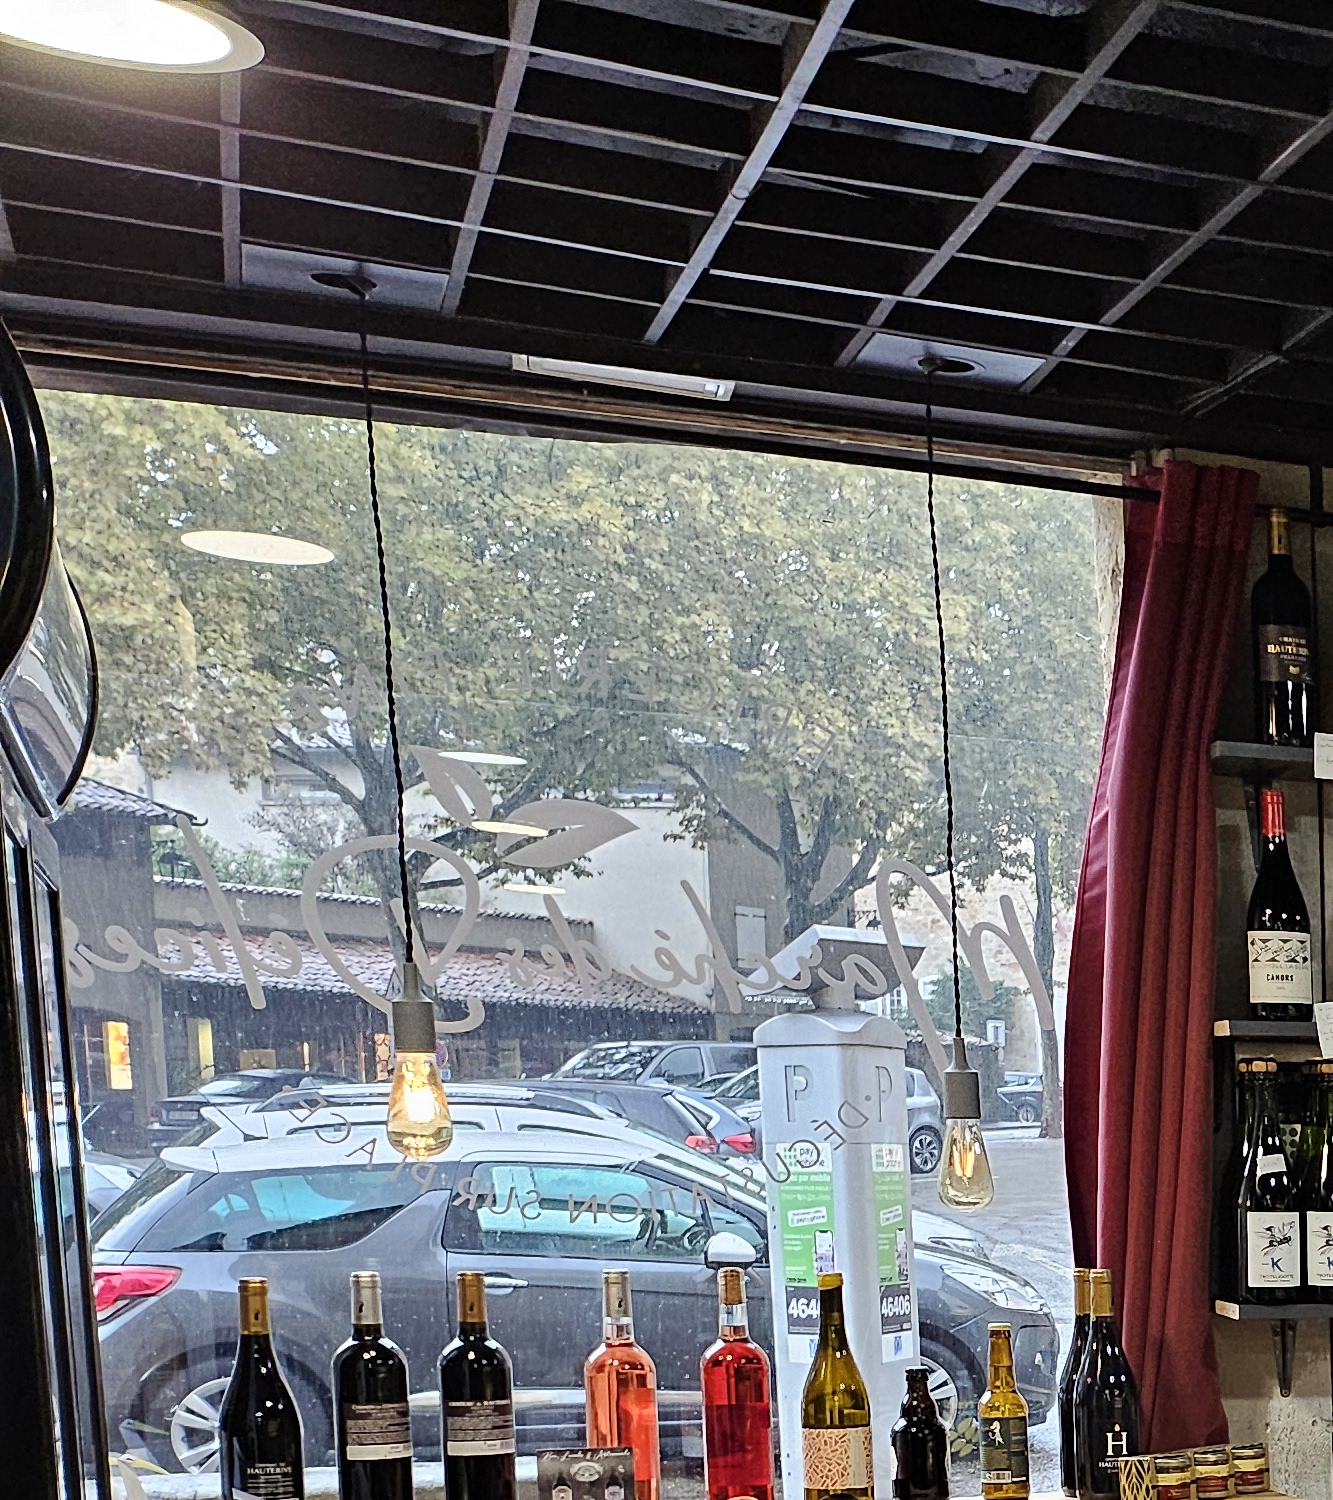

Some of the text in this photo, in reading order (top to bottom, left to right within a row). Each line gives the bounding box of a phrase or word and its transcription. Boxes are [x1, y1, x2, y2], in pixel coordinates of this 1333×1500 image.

[785, 1062, 807, 1123] P
[870, 1068, 892, 1123] P
[1270, 1256, 1282, 1273] K
[788, 1297, 819, 1319] 464
[881, 1291, 911, 1318] 46406
[1106, 1431, 1128, 1456] H
